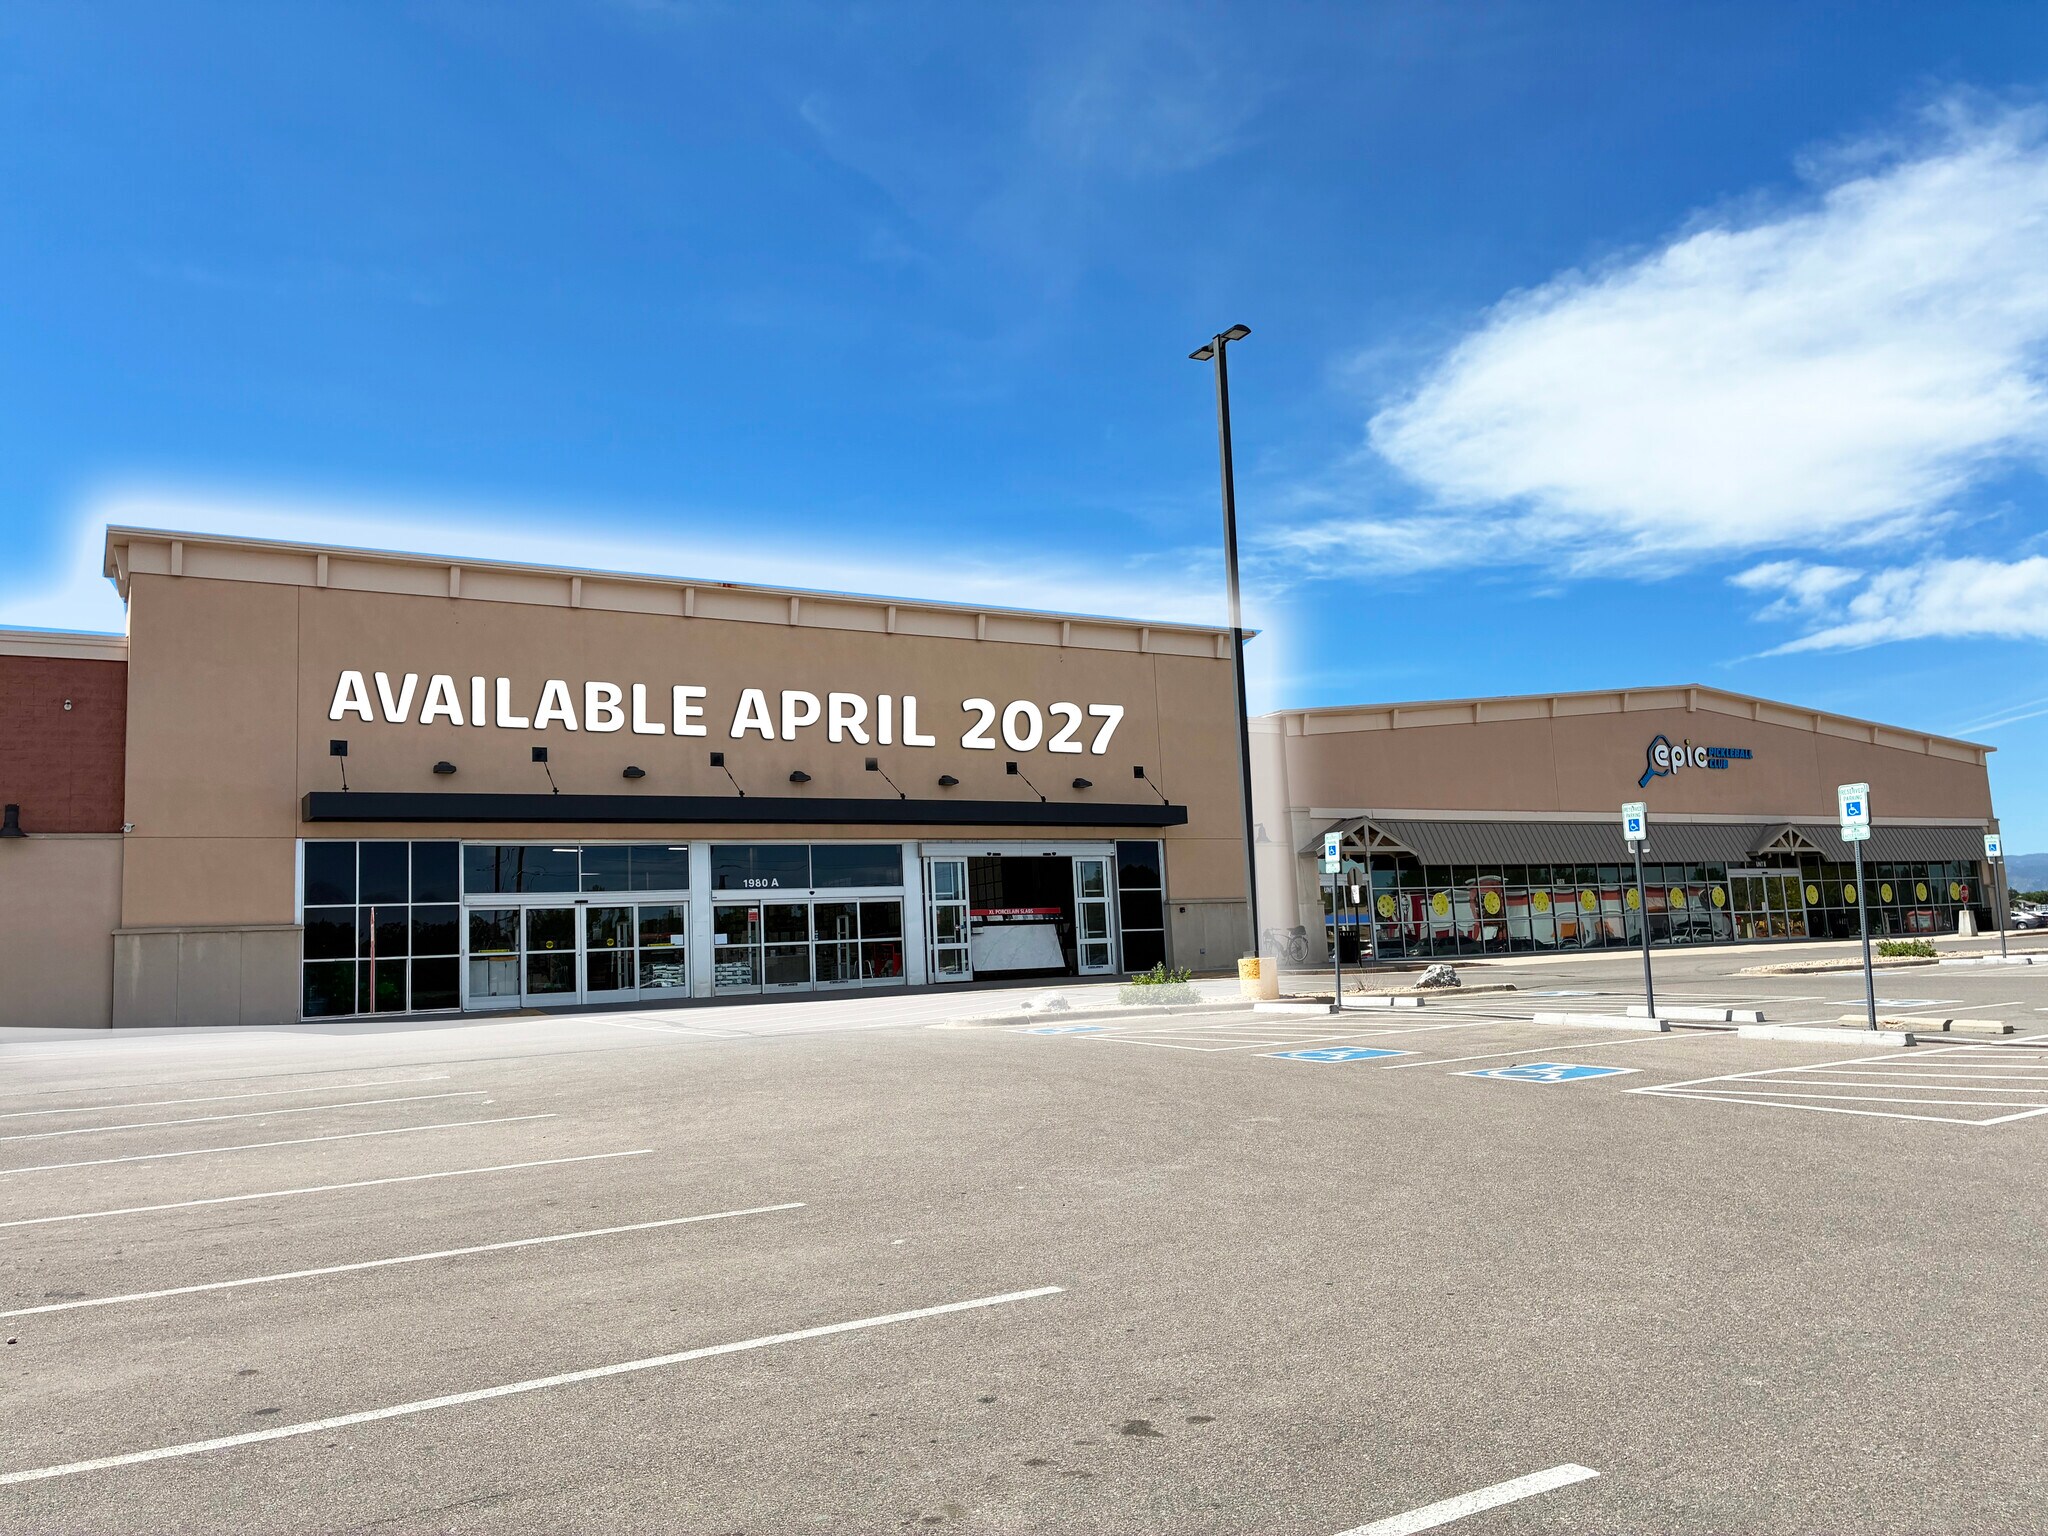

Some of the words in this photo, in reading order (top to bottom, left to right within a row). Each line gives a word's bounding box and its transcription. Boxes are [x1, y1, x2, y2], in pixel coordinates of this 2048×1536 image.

[1653, 738, 1708, 775] epic
[1707, 758, 1729, 769] CLUB
[743, 878, 769, 888] 1980
[771, 878, 779, 887] A
